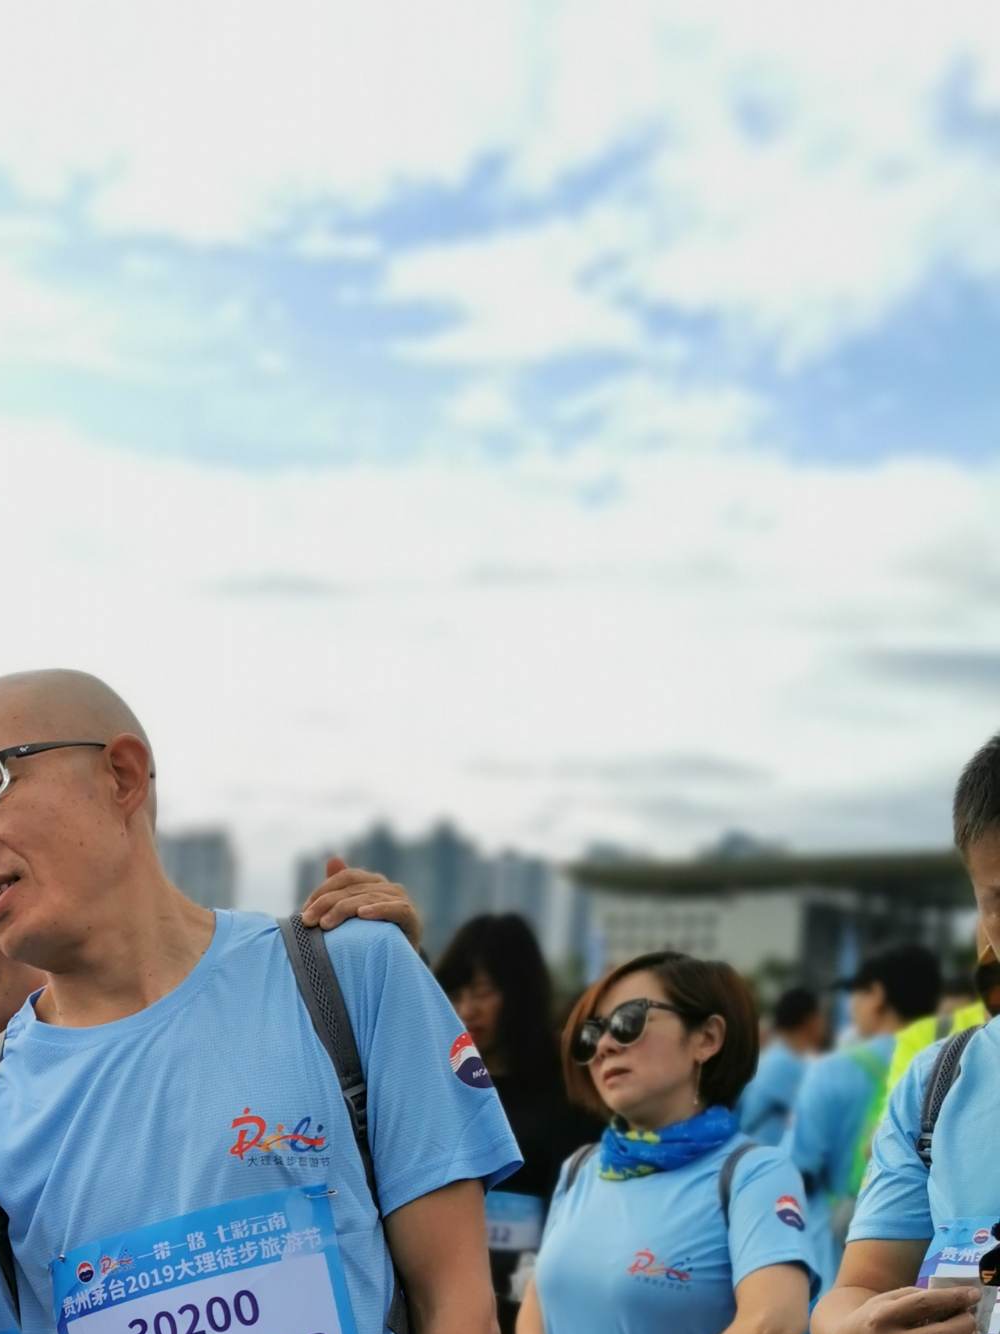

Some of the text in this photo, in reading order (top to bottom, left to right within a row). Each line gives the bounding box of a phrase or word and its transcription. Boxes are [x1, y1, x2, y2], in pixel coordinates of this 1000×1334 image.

[213, 1211, 289, 1244] 七彩云南
[62, 1226, 323, 1319] 贵州茅台2019大理徒步旅游节
